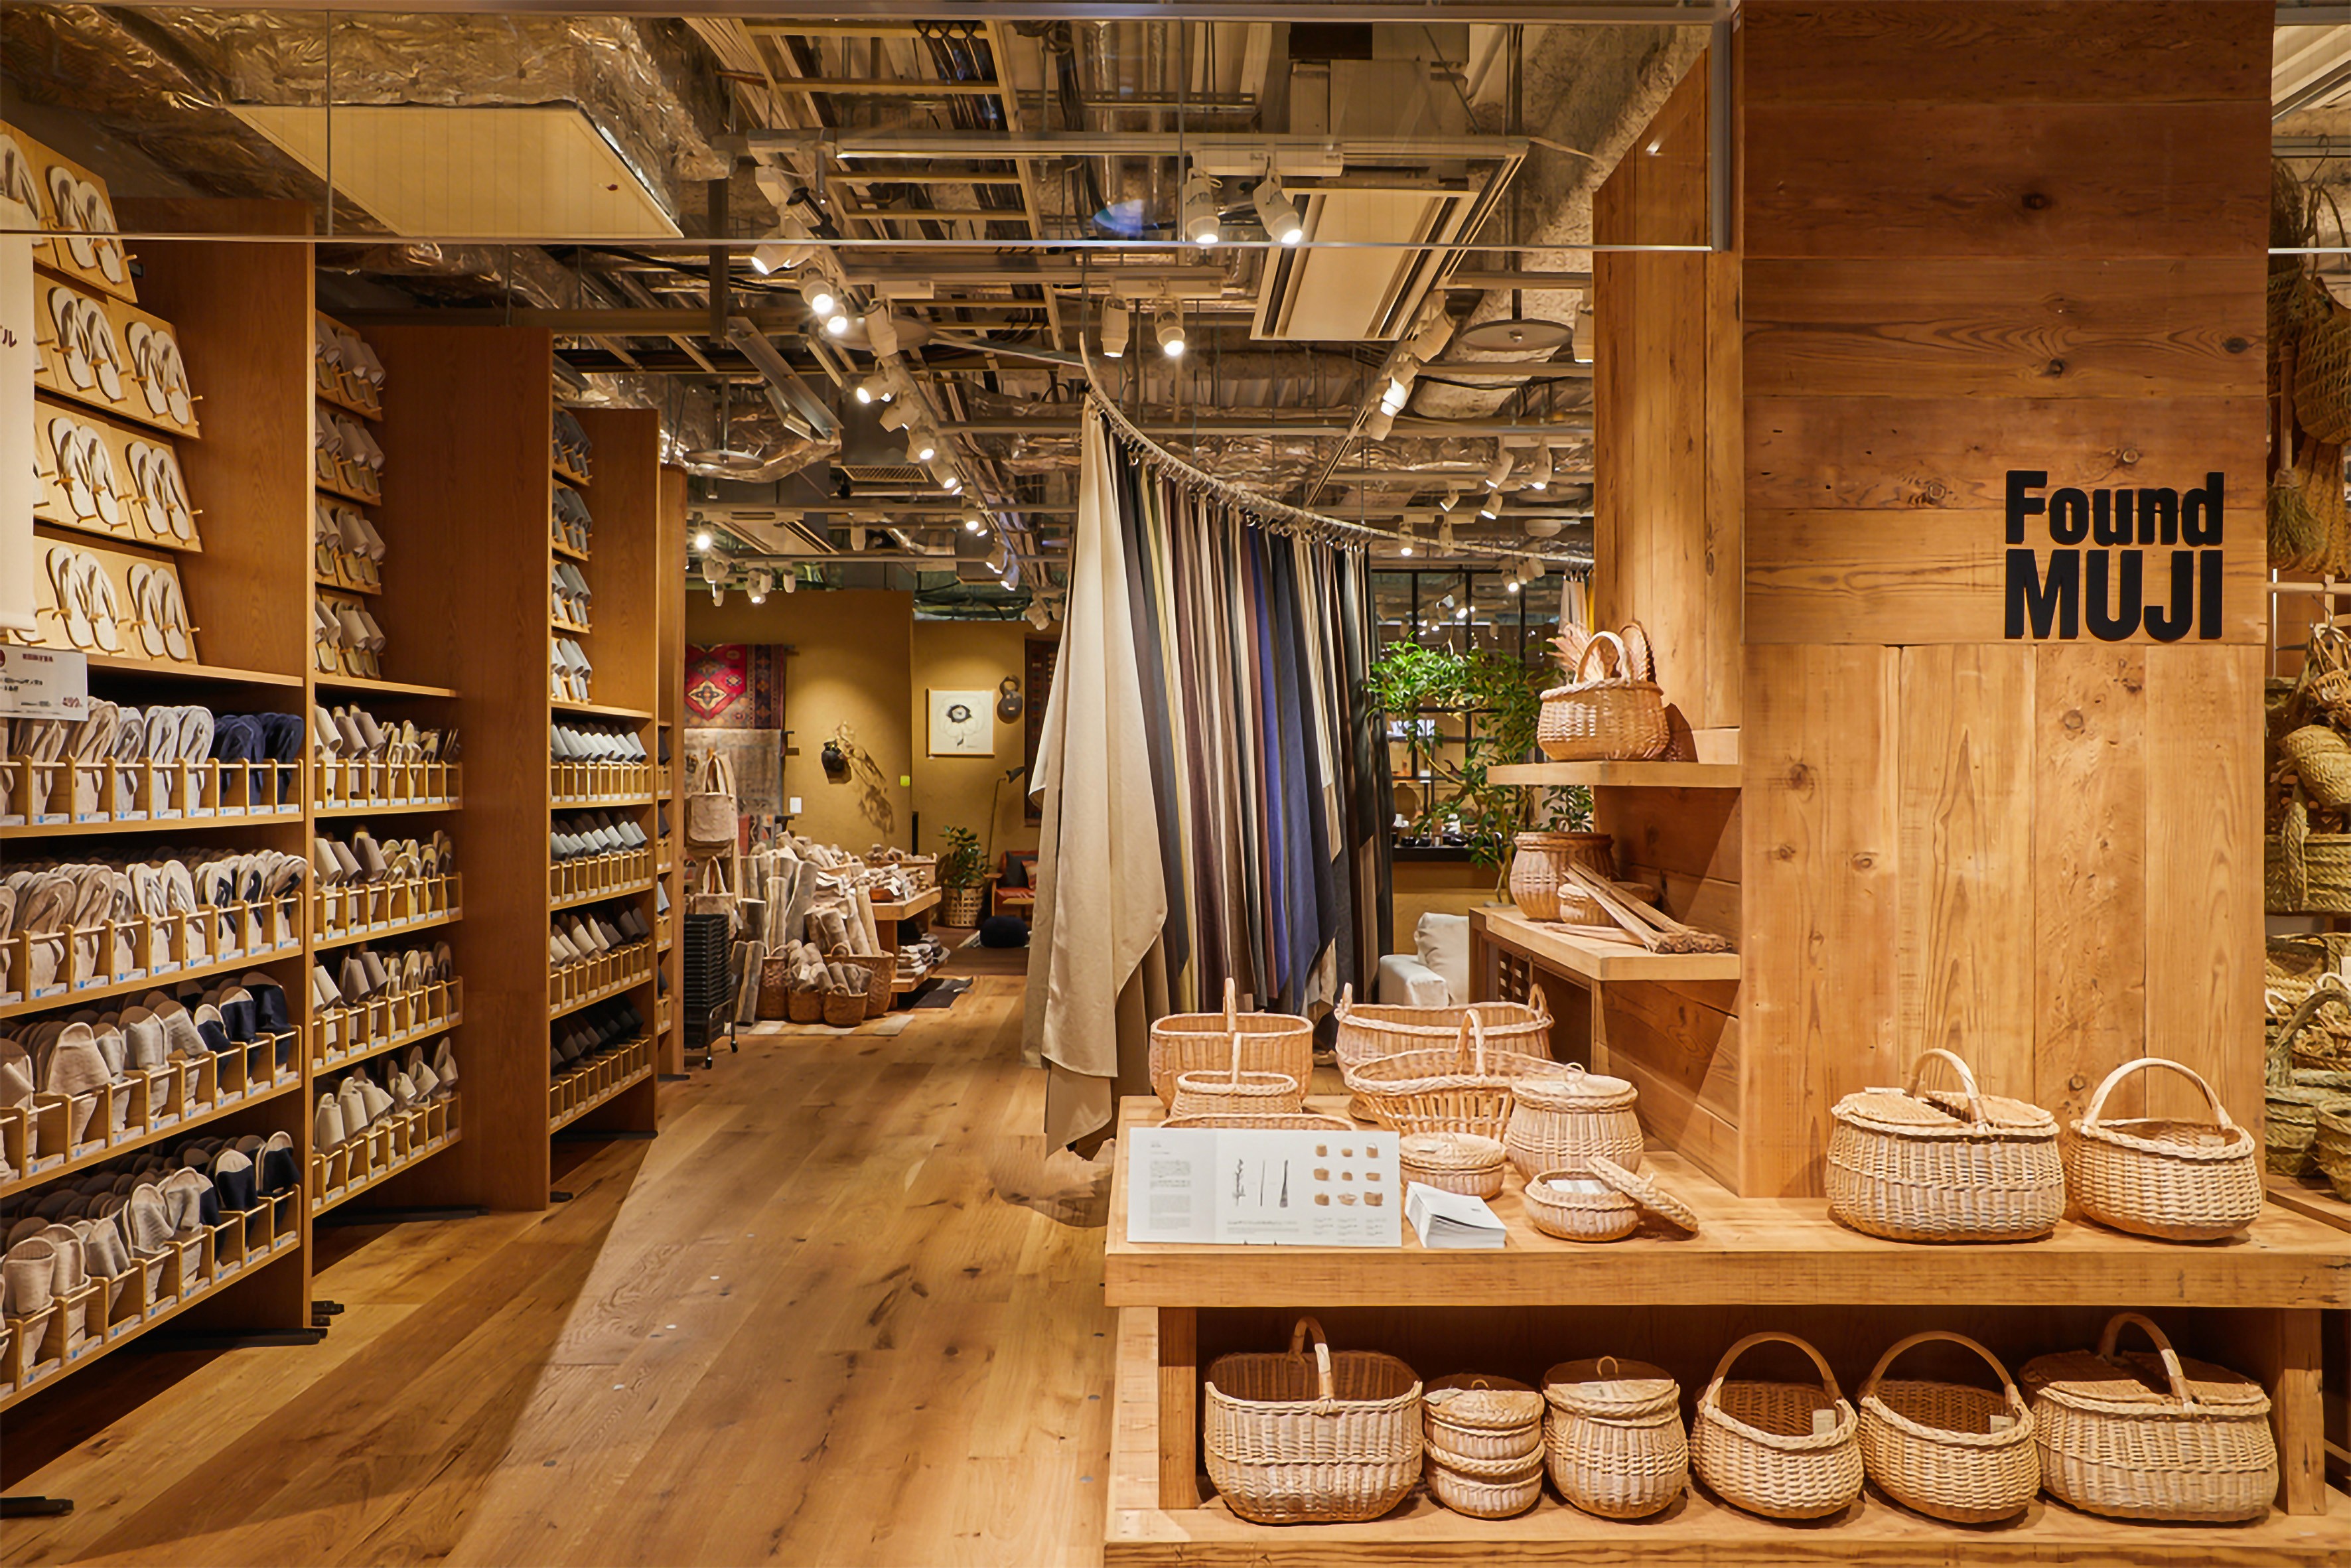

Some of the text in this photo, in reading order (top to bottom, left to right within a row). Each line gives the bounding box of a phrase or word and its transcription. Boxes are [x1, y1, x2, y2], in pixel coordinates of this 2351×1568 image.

[0, 325, 17, 348] ル
[2005, 470, 2224, 546] Found
[2005, 549, 2223, 642] MUJI
